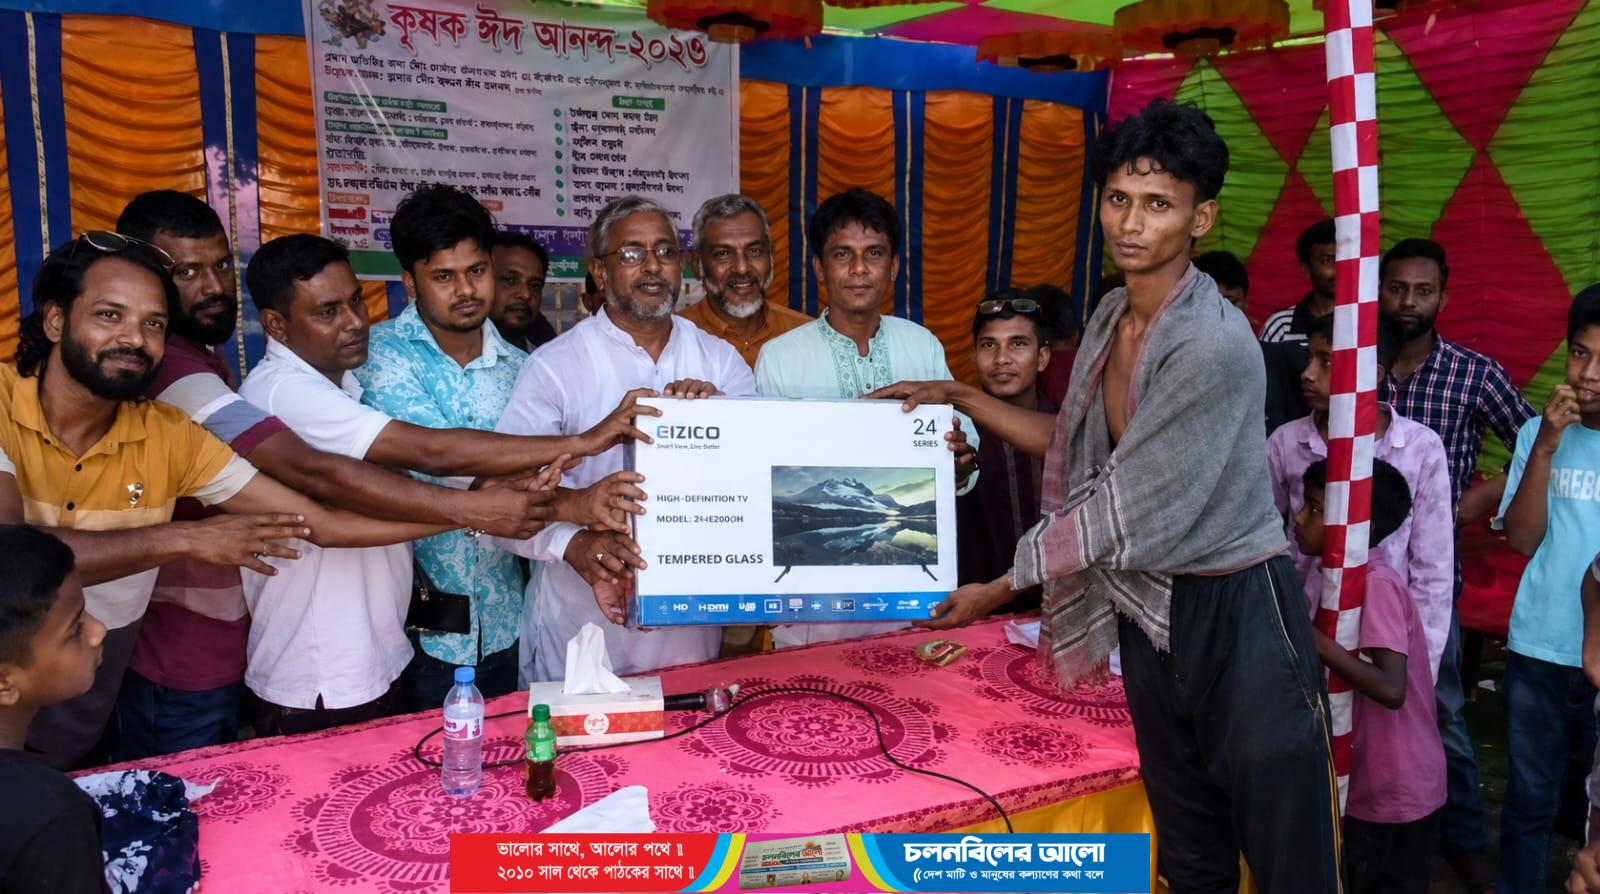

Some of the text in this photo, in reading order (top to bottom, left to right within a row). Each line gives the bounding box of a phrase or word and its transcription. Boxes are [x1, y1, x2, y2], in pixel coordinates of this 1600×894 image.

[386, 4, 467, 48] কৃষক
[475, 5, 522, 50] ঈদ
[913, 418, 937, 435] 24
[656, 425, 720, 440] EIZICO
[913, 440, 938, 448] SERIES
[737, 495, 749, 503] TV
[656, 515, 692, 523] MODEL:
[657, 554, 764, 565] TEMPERED GLASS
[673, 603, 689, 612] HD
